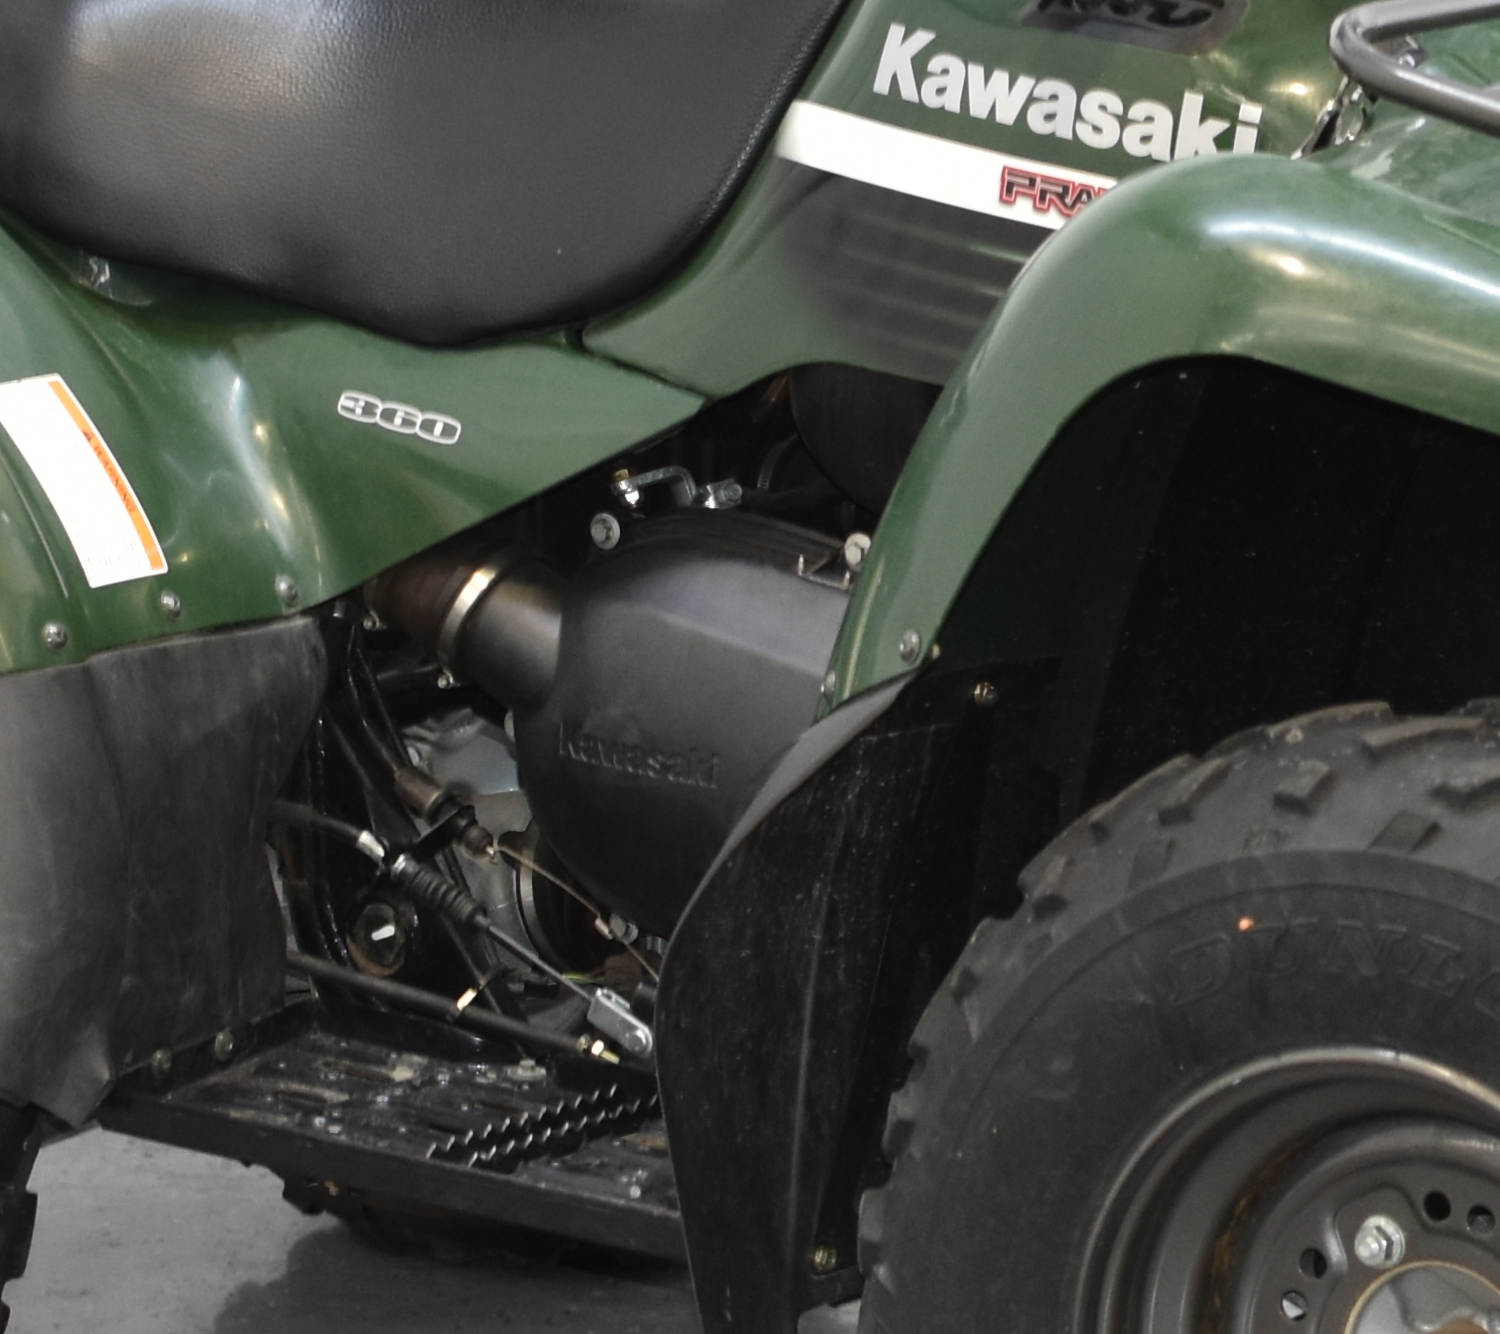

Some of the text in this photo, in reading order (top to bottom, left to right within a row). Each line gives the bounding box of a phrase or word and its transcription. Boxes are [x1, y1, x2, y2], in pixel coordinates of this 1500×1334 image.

[872, 22, 1263, 162] Kawasaki
[999, 165, 1108, 218] PRA
[337, 389, 462, 445] 360
